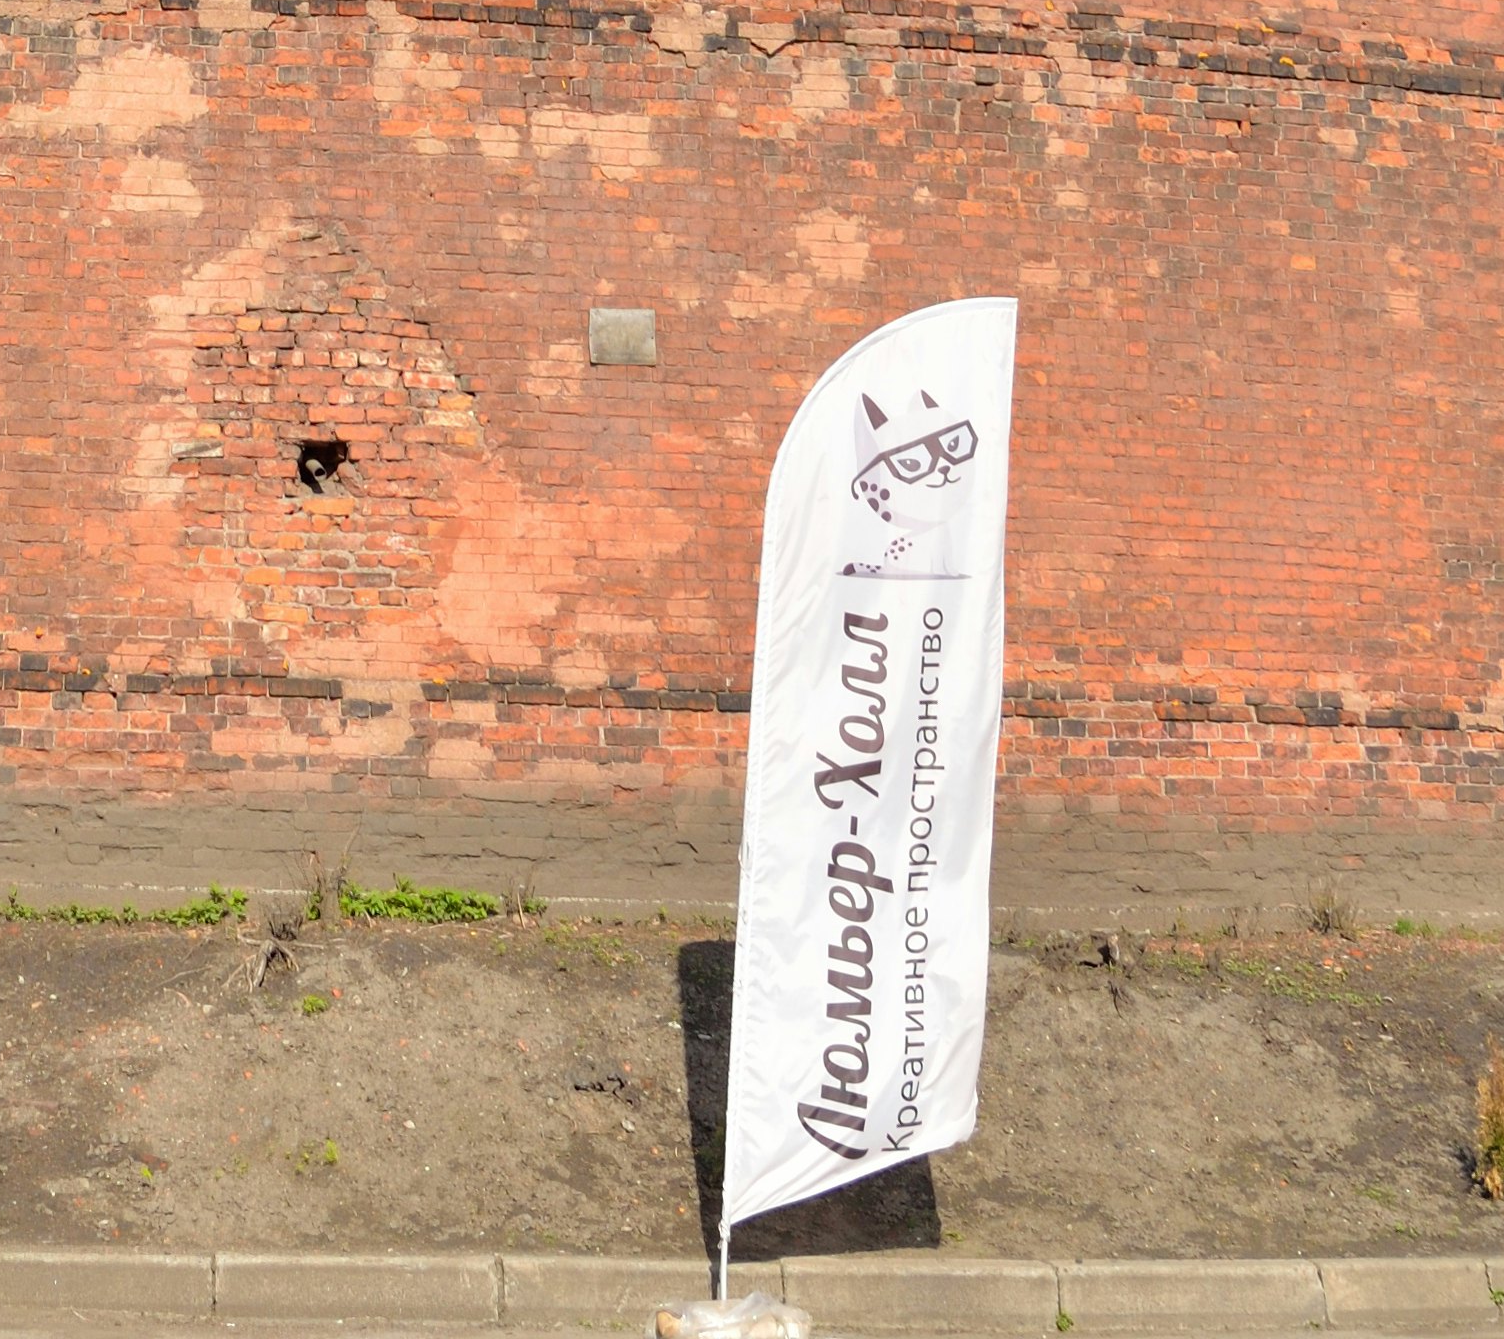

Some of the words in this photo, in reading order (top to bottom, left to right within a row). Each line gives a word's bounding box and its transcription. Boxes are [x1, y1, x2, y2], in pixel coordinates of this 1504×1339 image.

[797, 611, 894, 1160] Люмьер-Холл
[881, 906, 929, 1152] Креативное
[907, 607, 945, 892] пространство
